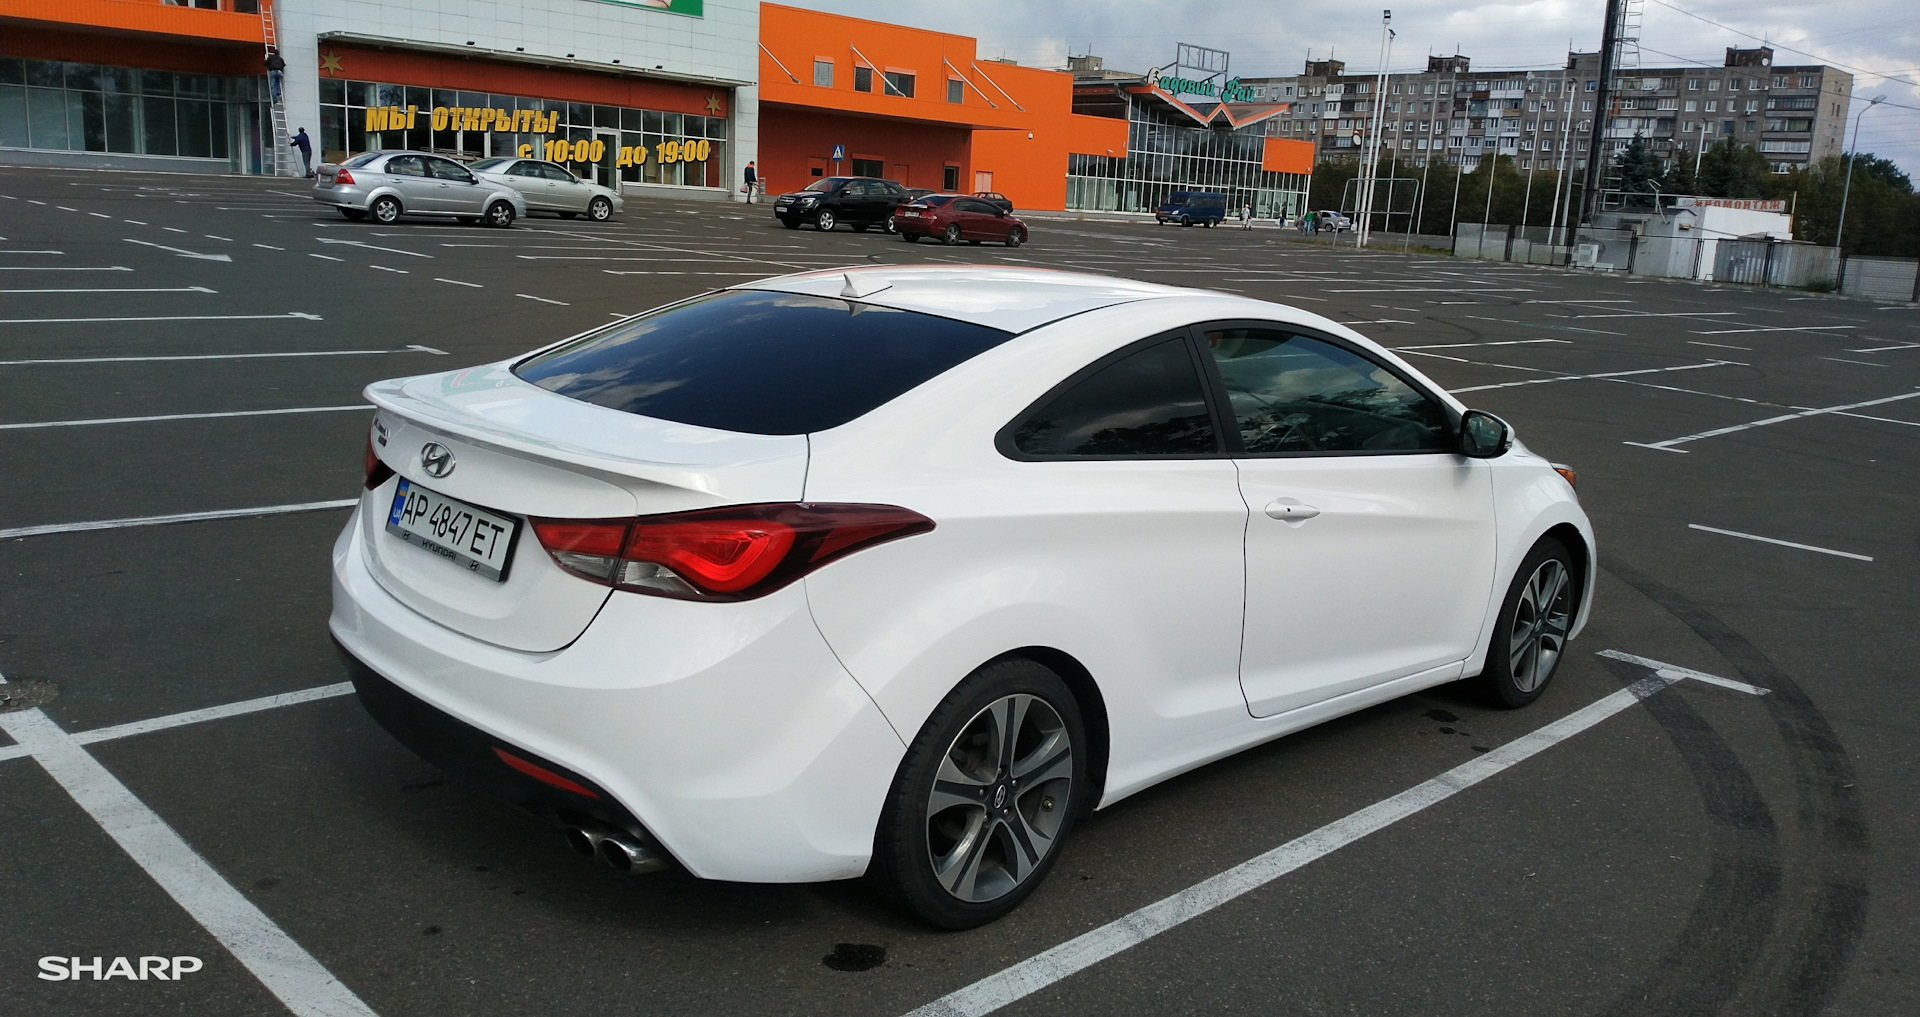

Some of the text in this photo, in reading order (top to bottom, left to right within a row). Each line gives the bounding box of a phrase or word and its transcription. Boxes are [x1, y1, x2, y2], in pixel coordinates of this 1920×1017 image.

[1222, 76, 1255, 103] Рай
[366, 105, 558, 133] МЫ ОТКРЫТЫ
[544, 139, 604, 164] 10:00
[616, 145, 647, 168] до
[656, 140, 709, 164] 19:00
[402, 491, 504, 559] AP 4847 ET
[422, 540, 457, 561] HYUNDAI
